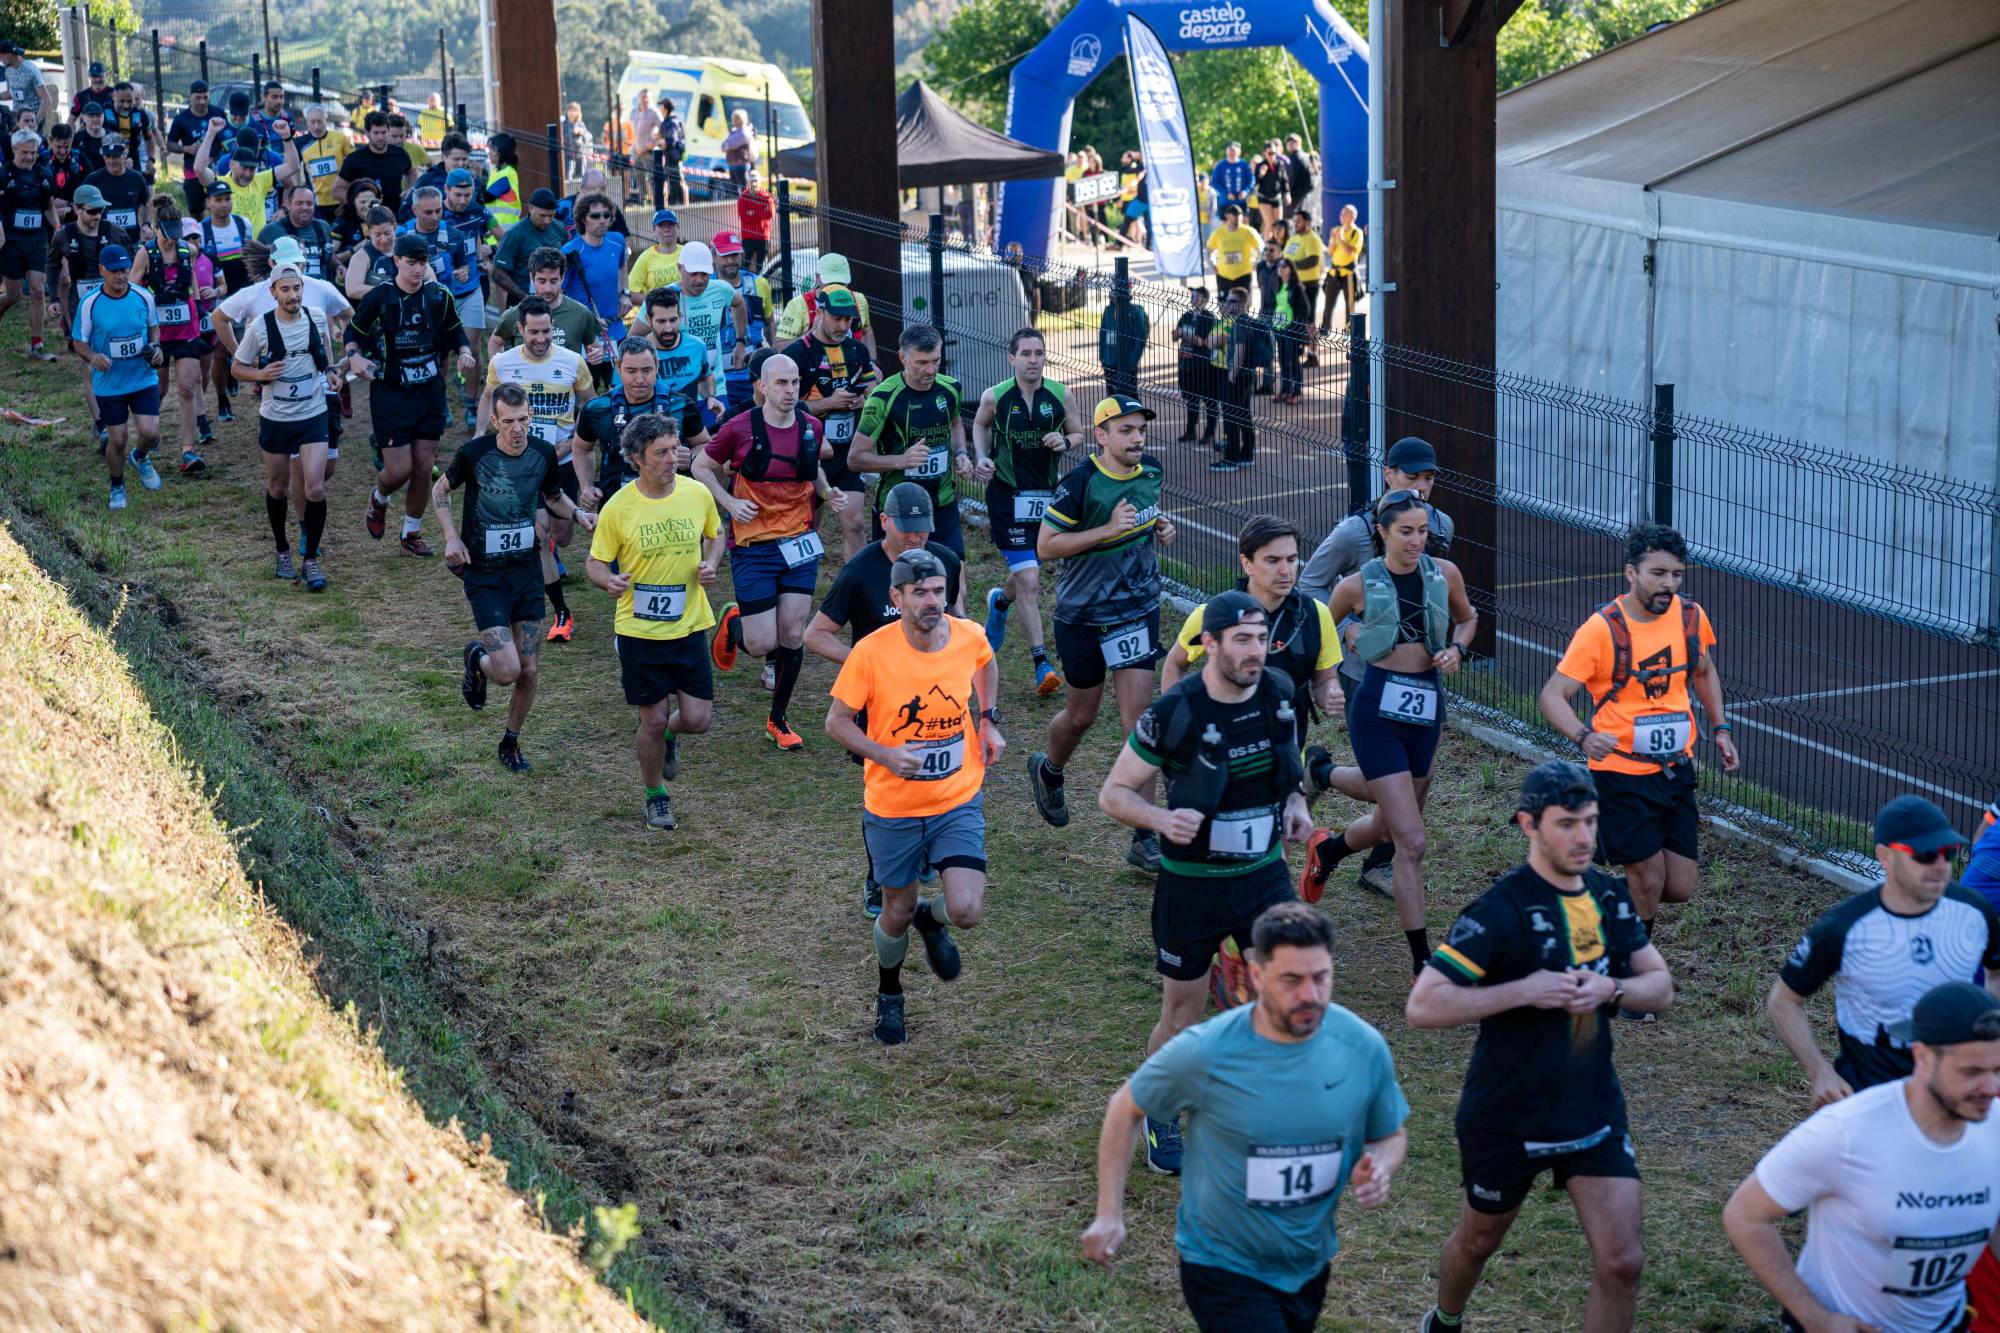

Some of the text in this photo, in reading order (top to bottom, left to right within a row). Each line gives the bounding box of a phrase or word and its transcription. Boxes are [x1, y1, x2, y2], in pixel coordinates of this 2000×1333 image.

[1179, 1, 1246, 24] castelo
[1179, 20, 1252, 41] deporte
[317, 162, 331, 174] 99
[23, 216, 35, 227] 61
[115, 215, 129, 226] 52
[165, 308, 182, 321] 39
[120, 342, 137, 356] 88
[289, 384, 299, 398] 2
[531, 383, 544, 392] 59
[1027, 500, 1044, 517] 76
[500, 531, 521, 551] 34
[641, 530, 696, 548] DO XALO
[647, 595, 672, 615] 42
[1117, 636, 1141, 660] 92
[1398, 690, 1425, 716] 23
[1649, 727, 1676, 752] 93
[922, 750, 951, 773] 40
[1242, 824, 1253, 851] 1
[1278, 1164, 1314, 1196] 14
[1908, 1253, 1968, 1287] 102
